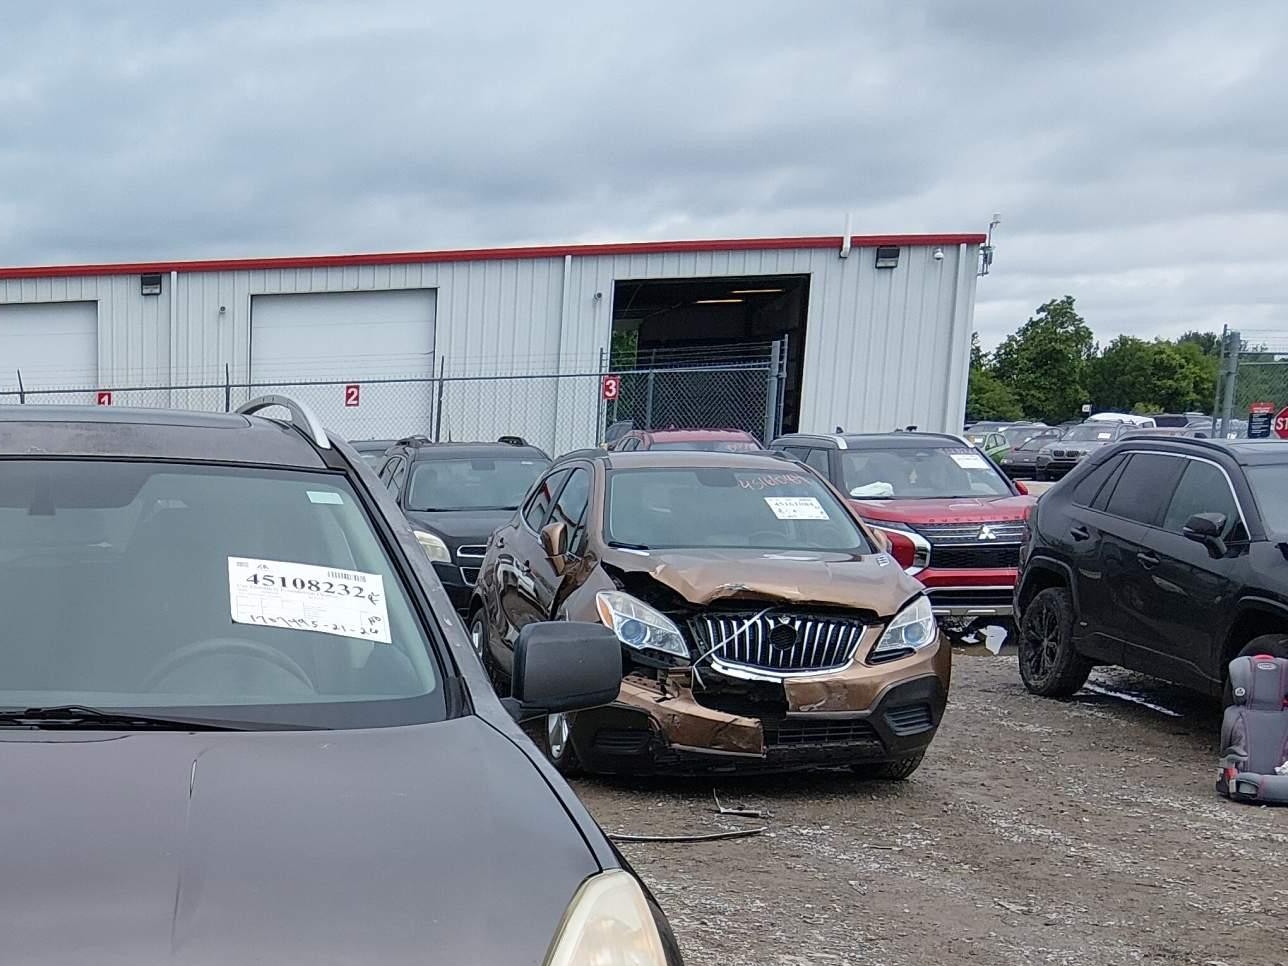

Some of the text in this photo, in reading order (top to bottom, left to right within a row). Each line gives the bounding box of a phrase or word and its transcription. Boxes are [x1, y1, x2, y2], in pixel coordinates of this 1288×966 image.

[346, 387, 358, 405] 2
[604, 379, 617, 397] 3
[246, 573, 366, 599] 45108232
